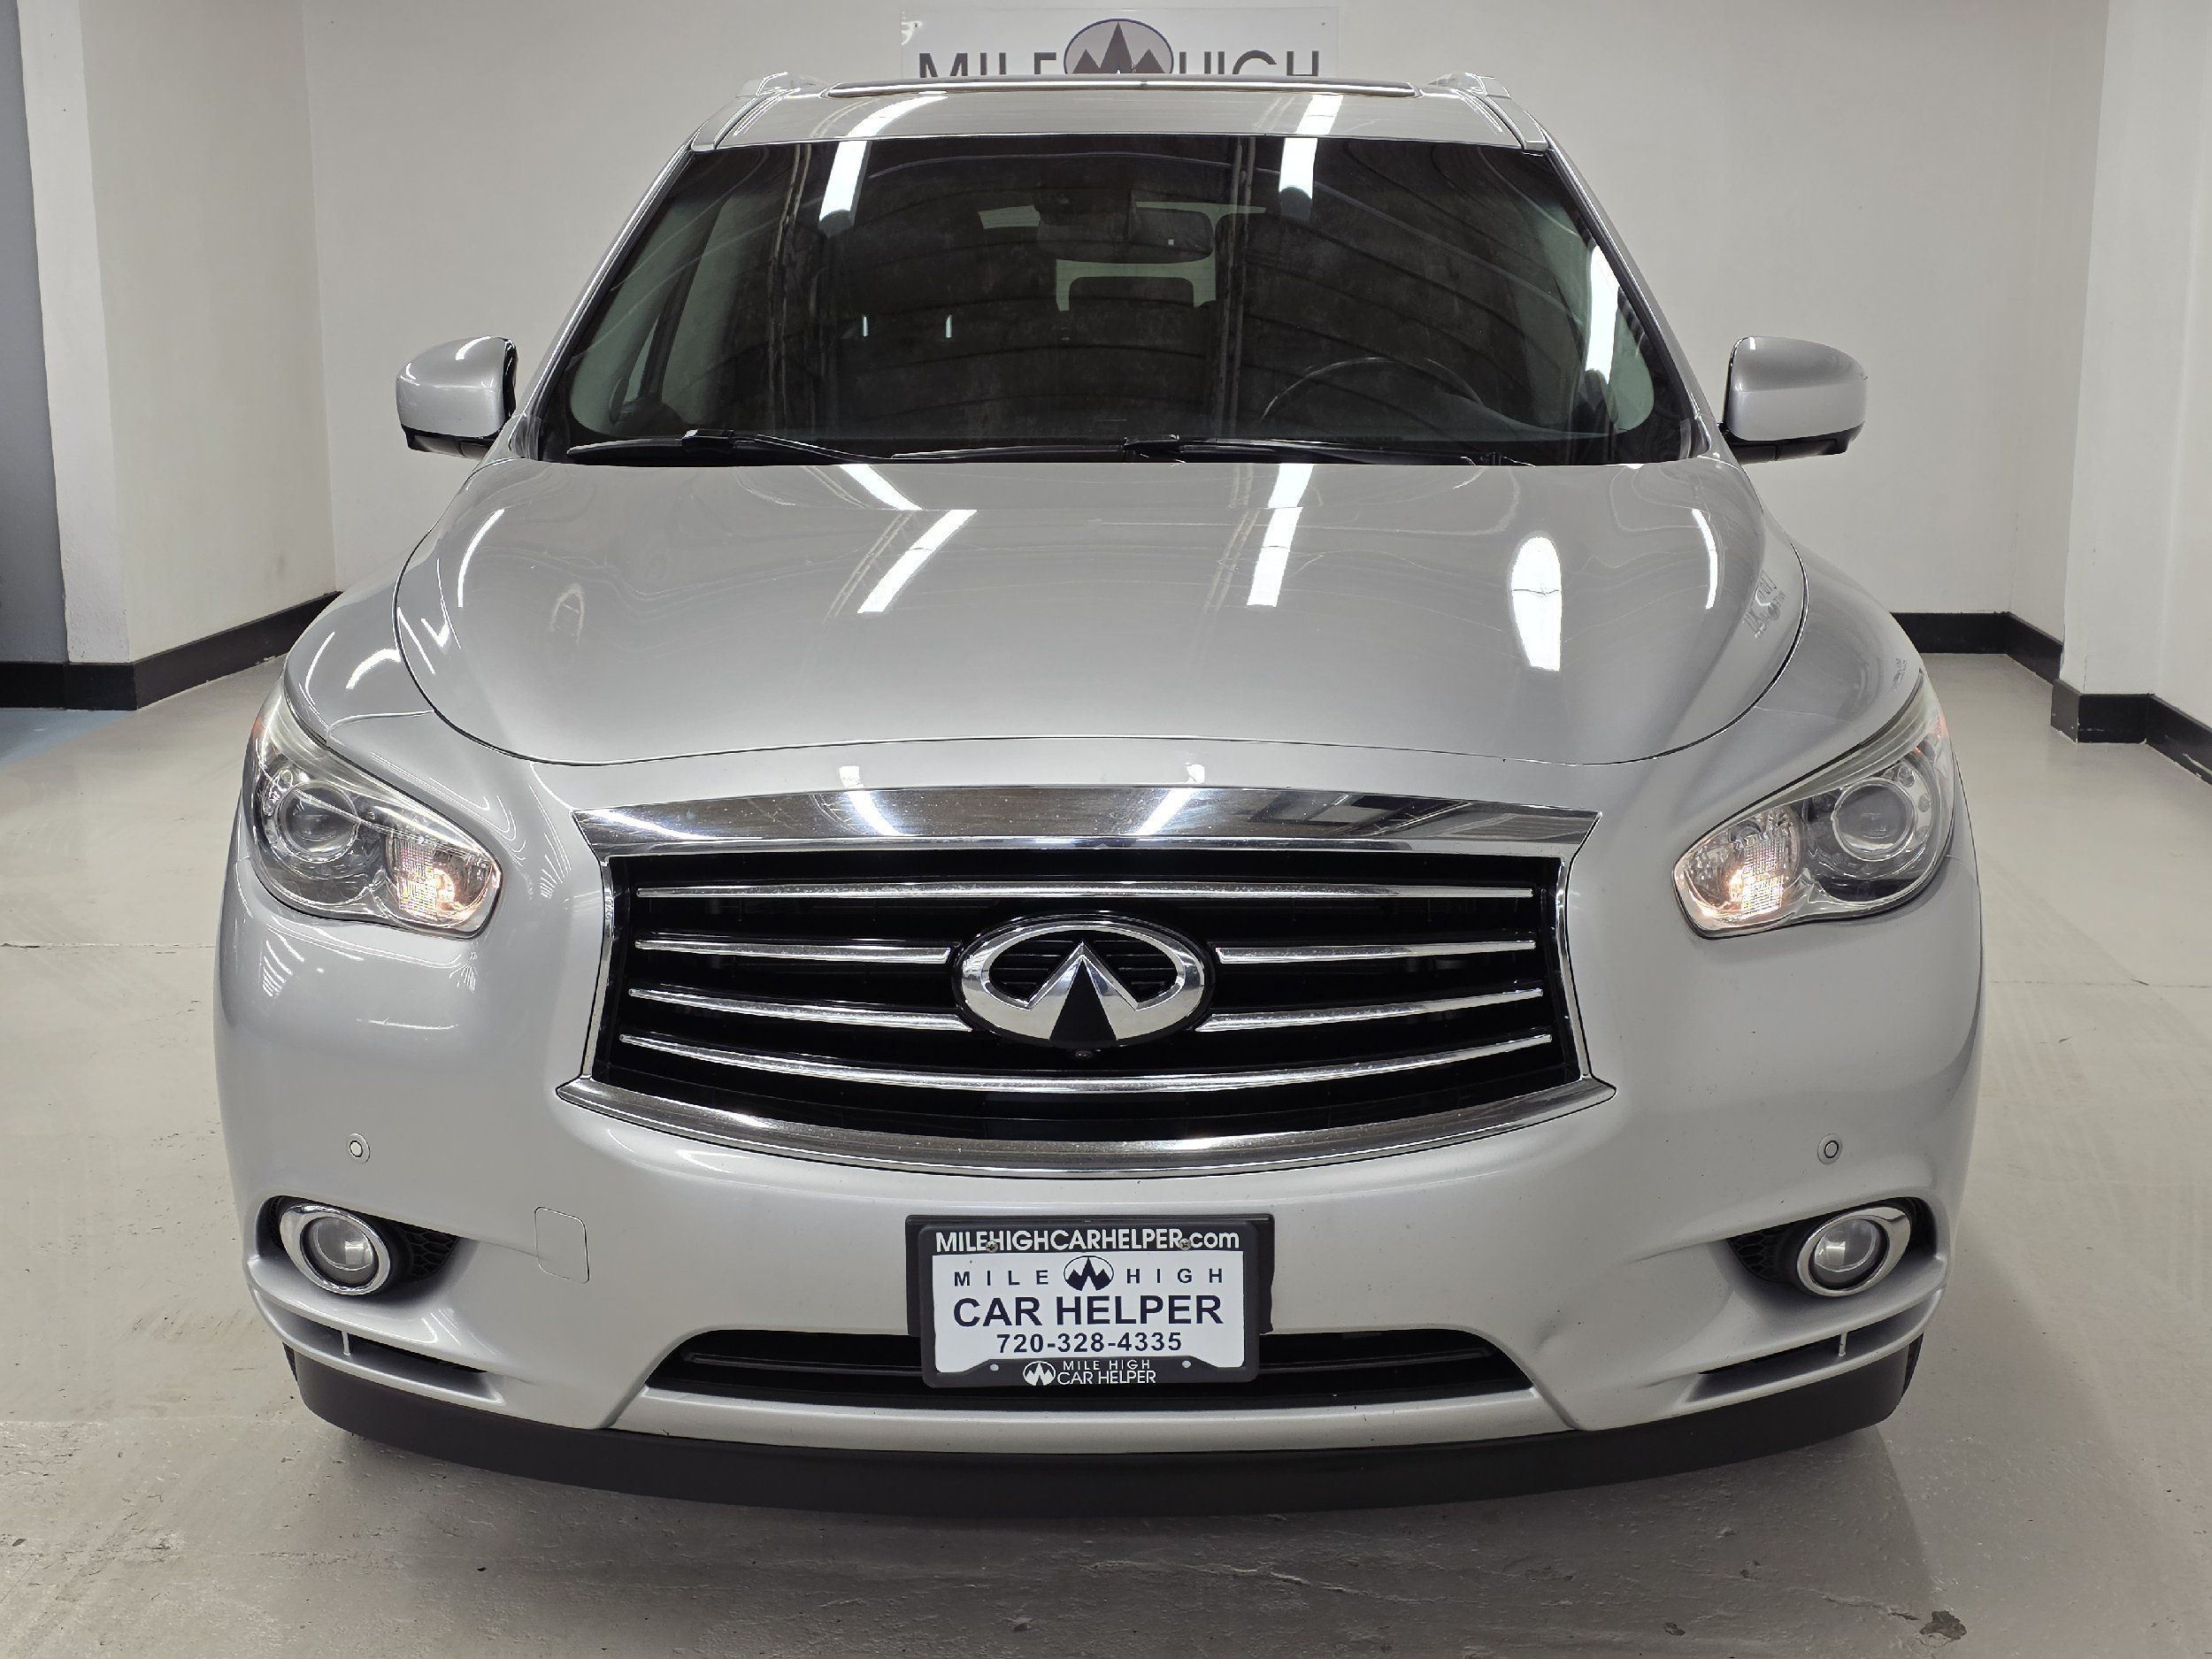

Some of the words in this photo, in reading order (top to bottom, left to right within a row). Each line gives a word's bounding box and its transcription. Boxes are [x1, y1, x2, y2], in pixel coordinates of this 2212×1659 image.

[935, 1228, 1240, 1253] MILEHIGHCARHELPERcom
[954, 1270, 1048, 1286] MILE
[1126, 1268, 1223, 1284] HIGH
[954, 1297, 1043, 1327] CAR
[1056, 1294, 1224, 1325] HELPER
[996, 1332, 1182, 1354] 720-328-4335
[1063, 1360, 1100, 1371] MILE
[1109, 1359, 1150, 1371] HIGH
[1056, 1371, 1094, 1386] CAR
[1098, 1370, 1157, 1385] HELPER
